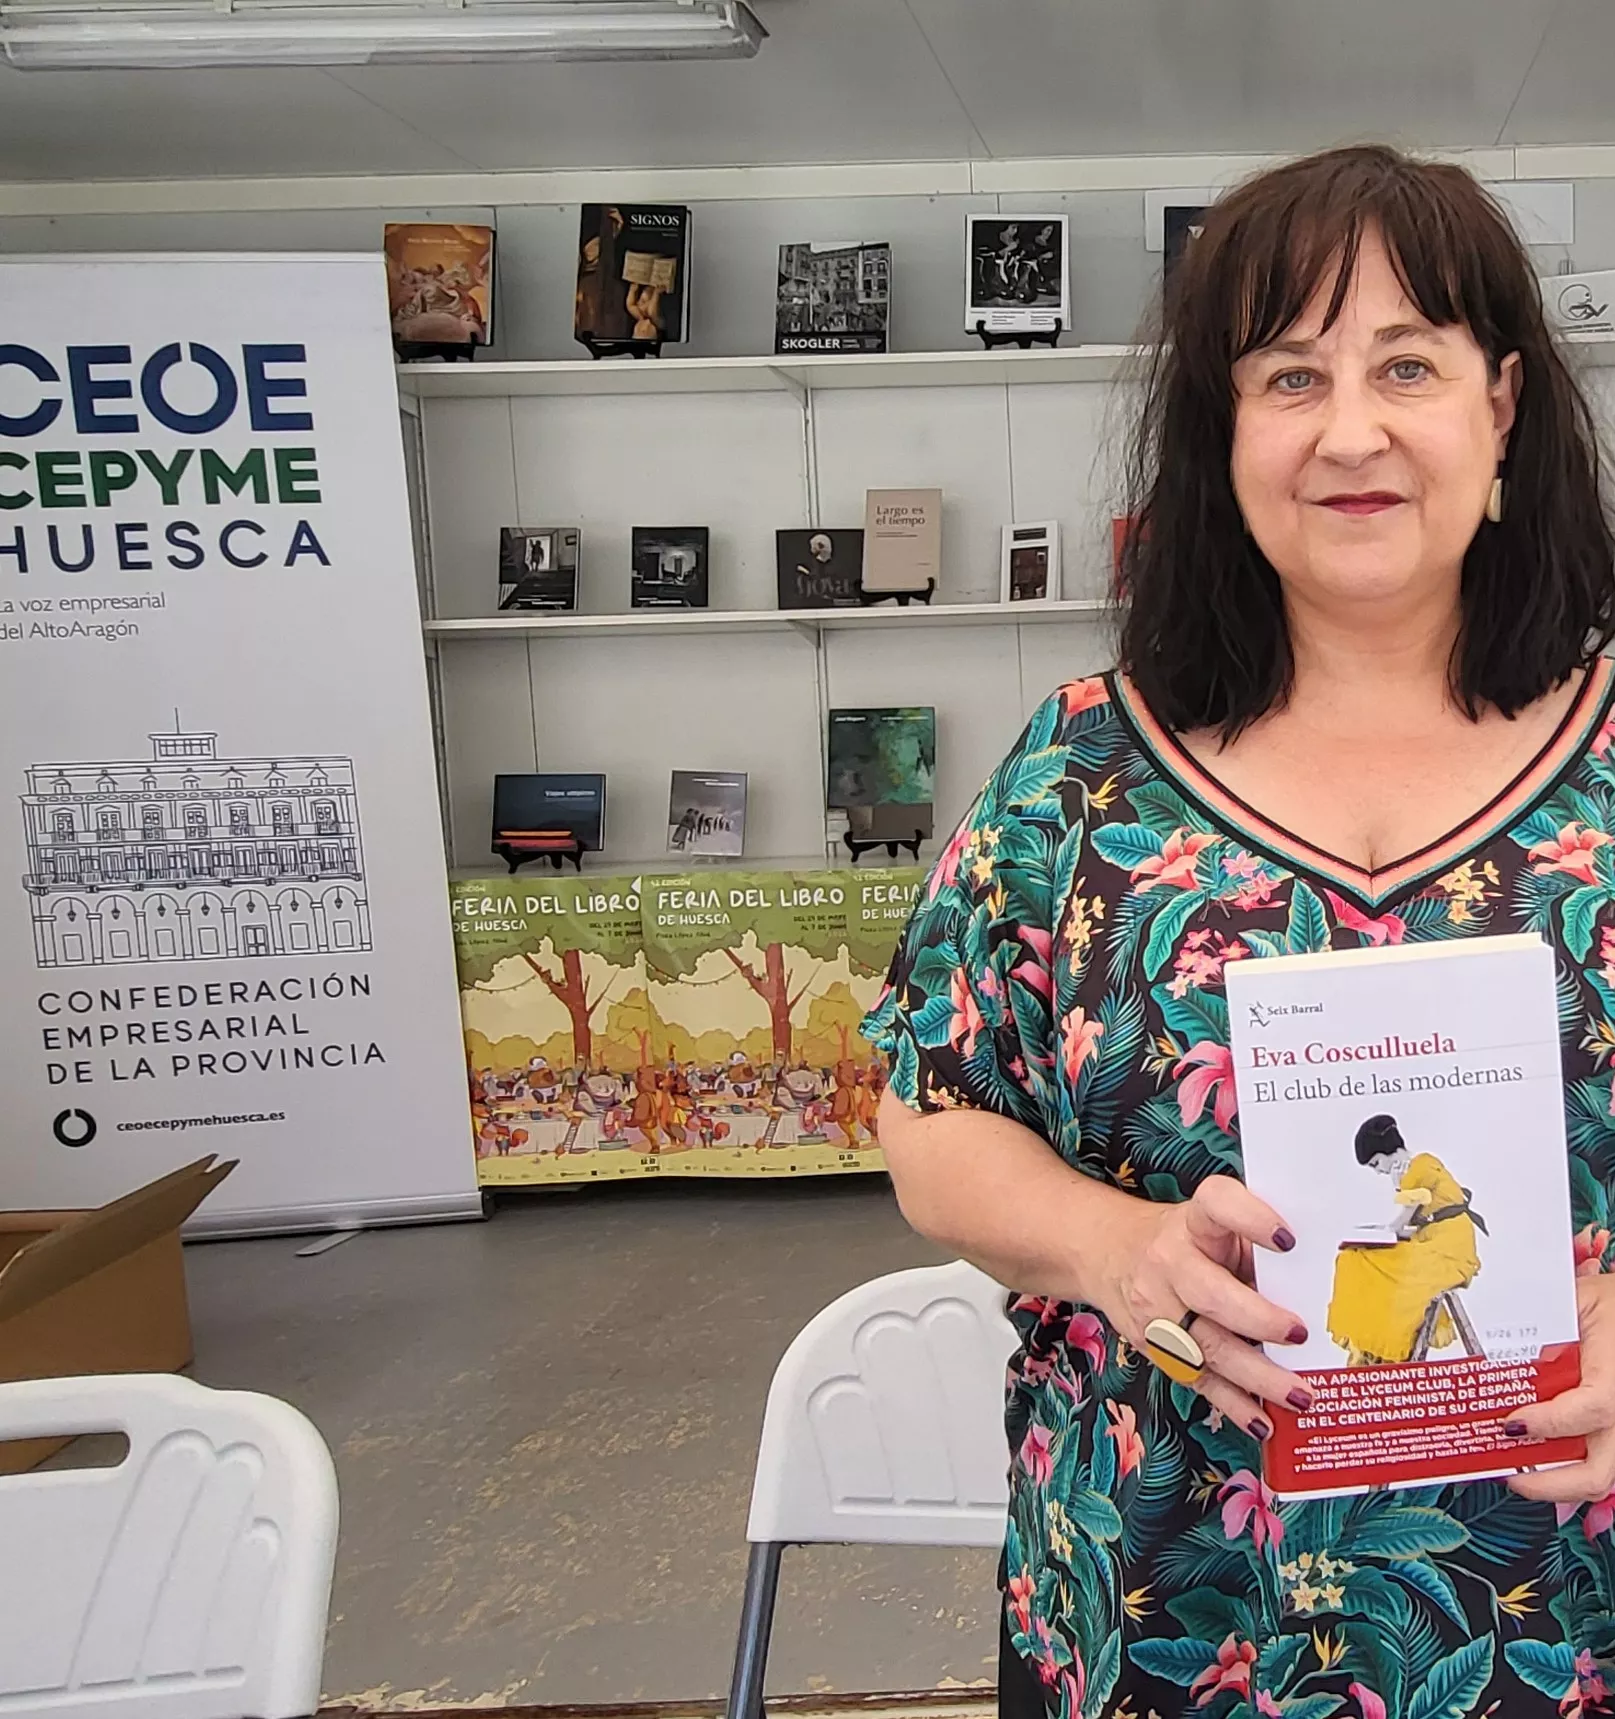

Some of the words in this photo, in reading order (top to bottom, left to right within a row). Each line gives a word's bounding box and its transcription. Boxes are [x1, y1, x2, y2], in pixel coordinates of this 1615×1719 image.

[630, 214, 680, 226] SIGNOS
[782, 339, 840, 349] SKOGLER
[0, 342, 314, 437] CEOE
[0, 447, 322, 510] CEPYME
[876, 505, 908, 518] Largo
[911, 506, 924, 515] es
[876, 516, 886, 525] el
[889, 516, 925, 528] tiempo
[0, 600, 14, 613] a
[20, 599, 53, 612] voz
[59, 592, 165, 614] empresarial
[29, 620, 139, 641] AltoAragón
[453, 896, 517, 917] FERIA
[525, 895, 567, 915] DEL
[575, 894, 640, 914] LIBRO
[659, 889, 720, 909] FERIA
[730, 889, 772, 907] DEL
[780, 888, 844, 907] LIBRO
[658, 914, 675, 925] DE
[680, 913, 730, 925] HUESCA
[862, 908, 879, 920] DE
[884, 907, 908, 919] HUE
[454, 921, 469, 932] DE
[475, 919, 527, 932] HUESCA
[38, 973, 371, 1015] CONFEDERACIÓN
[1267, 1005, 1288, 1016] Seix
[1291, 1003, 1323, 1014] Barral
[43, 1013, 309, 1050] EMPRESARIAL
[1252, 1047, 1297, 1068] Eva
[1304, 1033, 1456, 1064] Cosculluela
[47, 1061, 94, 1085] DE
[111, 1057, 156, 1081] LA
[172, 1043, 386, 1077] PROVINCIA
[1254, 1081, 1276, 1103] El
[1284, 1078, 1331, 1100] club
[1339, 1075, 1365, 1097] de
[1371, 1073, 1402, 1094] las
[1408, 1066, 1523, 1091] modernas
[117, 1111, 286, 1131] ceoecepymehuesca.es
[1303, 1375, 1327, 1386] NA
[1331, 1368, 1425, 1385] APASIONANTE
[1342, 1387, 1358, 1398] EL
[1361, 1381, 1413, 1396] LYCEUM
[1416, 1378, 1455, 1391] CLUB,
[1458, 1375, 1476, 1387] LA
[1479, 1366, 1538, 1384] PRIMERA
[1299, 1397, 1382, 1414] SOCIACIÓN
[1385, 1391, 1455, 1407] FEMINISTA
[1458, 1388, 1476, 1400] DE
[1479, 1380, 1535, 1397] ESPAÑA,
[1298, 1416, 1316, 1428] EN
[1320, 1415, 1336, 1426] EL
[1338, 1408, 1425, 1425] CENTENARIO
[1428, 1405, 1446, 1417] DE
[1449, 1402, 1466, 1414] SU
[1469, 1392, 1537, 1411] CREACIÓN
[1323, 1434, 1356, 1444] Lyceum
[1341, 1442, 1373, 1450] nuestra
[1323, 1452, 1347, 1460] mujer
[1377, 1452, 1427, 1464] religiosidad
